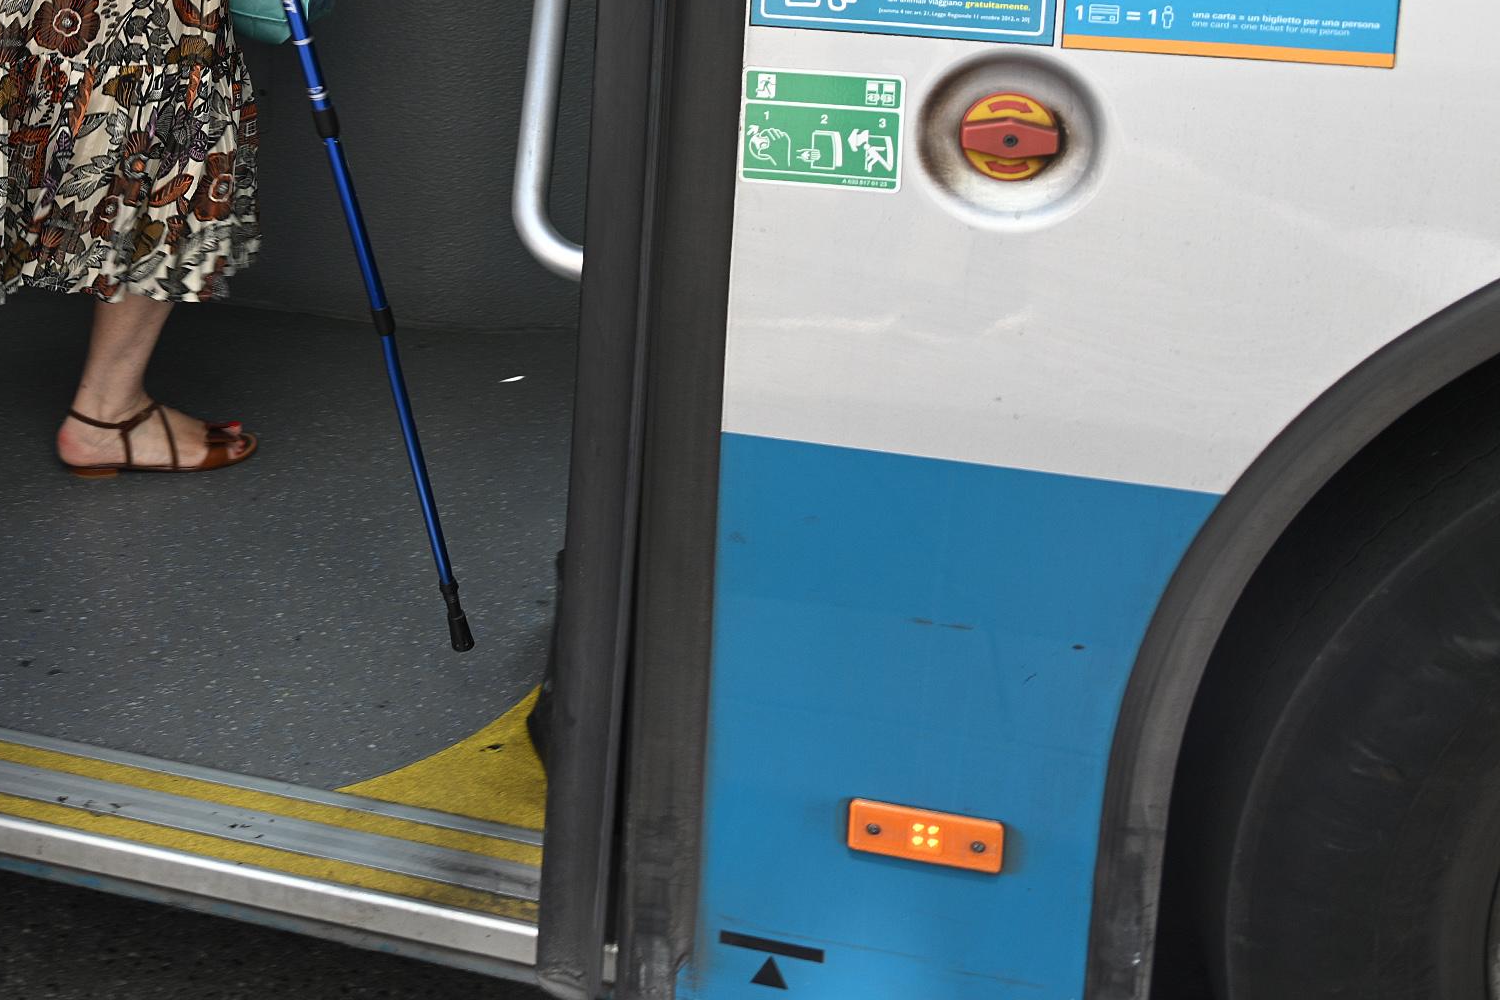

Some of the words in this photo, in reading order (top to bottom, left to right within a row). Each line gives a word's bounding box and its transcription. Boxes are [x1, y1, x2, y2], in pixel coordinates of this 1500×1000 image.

[965, 0, 1031, 12] gratuitamente.
[1075, 4, 1084, 20] 1
[1148, 8, 1157, 25] 1
[1262, 14, 1301, 24] biglietto
[1342, 21, 1380, 29] persona
[1210, 21, 1229, 29] card
[1319, 28, 1350, 36] person
[763, 110, 769, 120] 1
[820, 114, 828, 124] 2
[879, 118, 886, 128] 3
